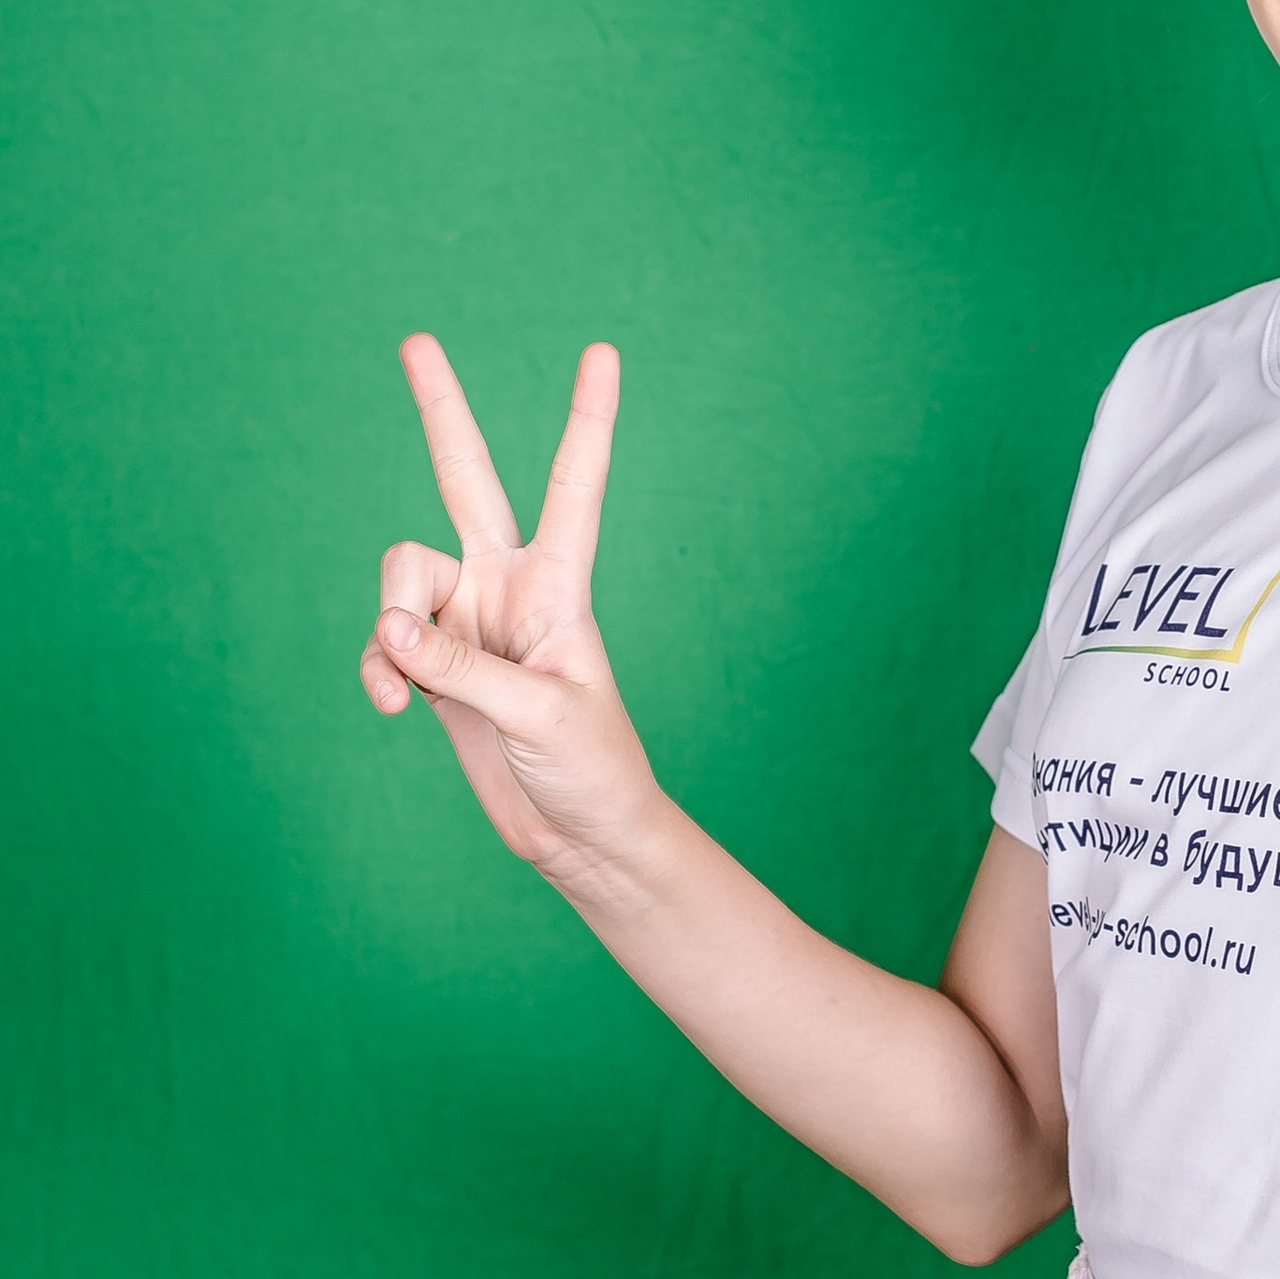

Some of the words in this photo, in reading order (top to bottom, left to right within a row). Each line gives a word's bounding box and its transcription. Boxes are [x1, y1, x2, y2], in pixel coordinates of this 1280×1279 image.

[1081, 564, 1235, 639] LEVEL
[1143, 662, 1231, 692] SCHOOL
[1150, 832, 1169, 867] в
